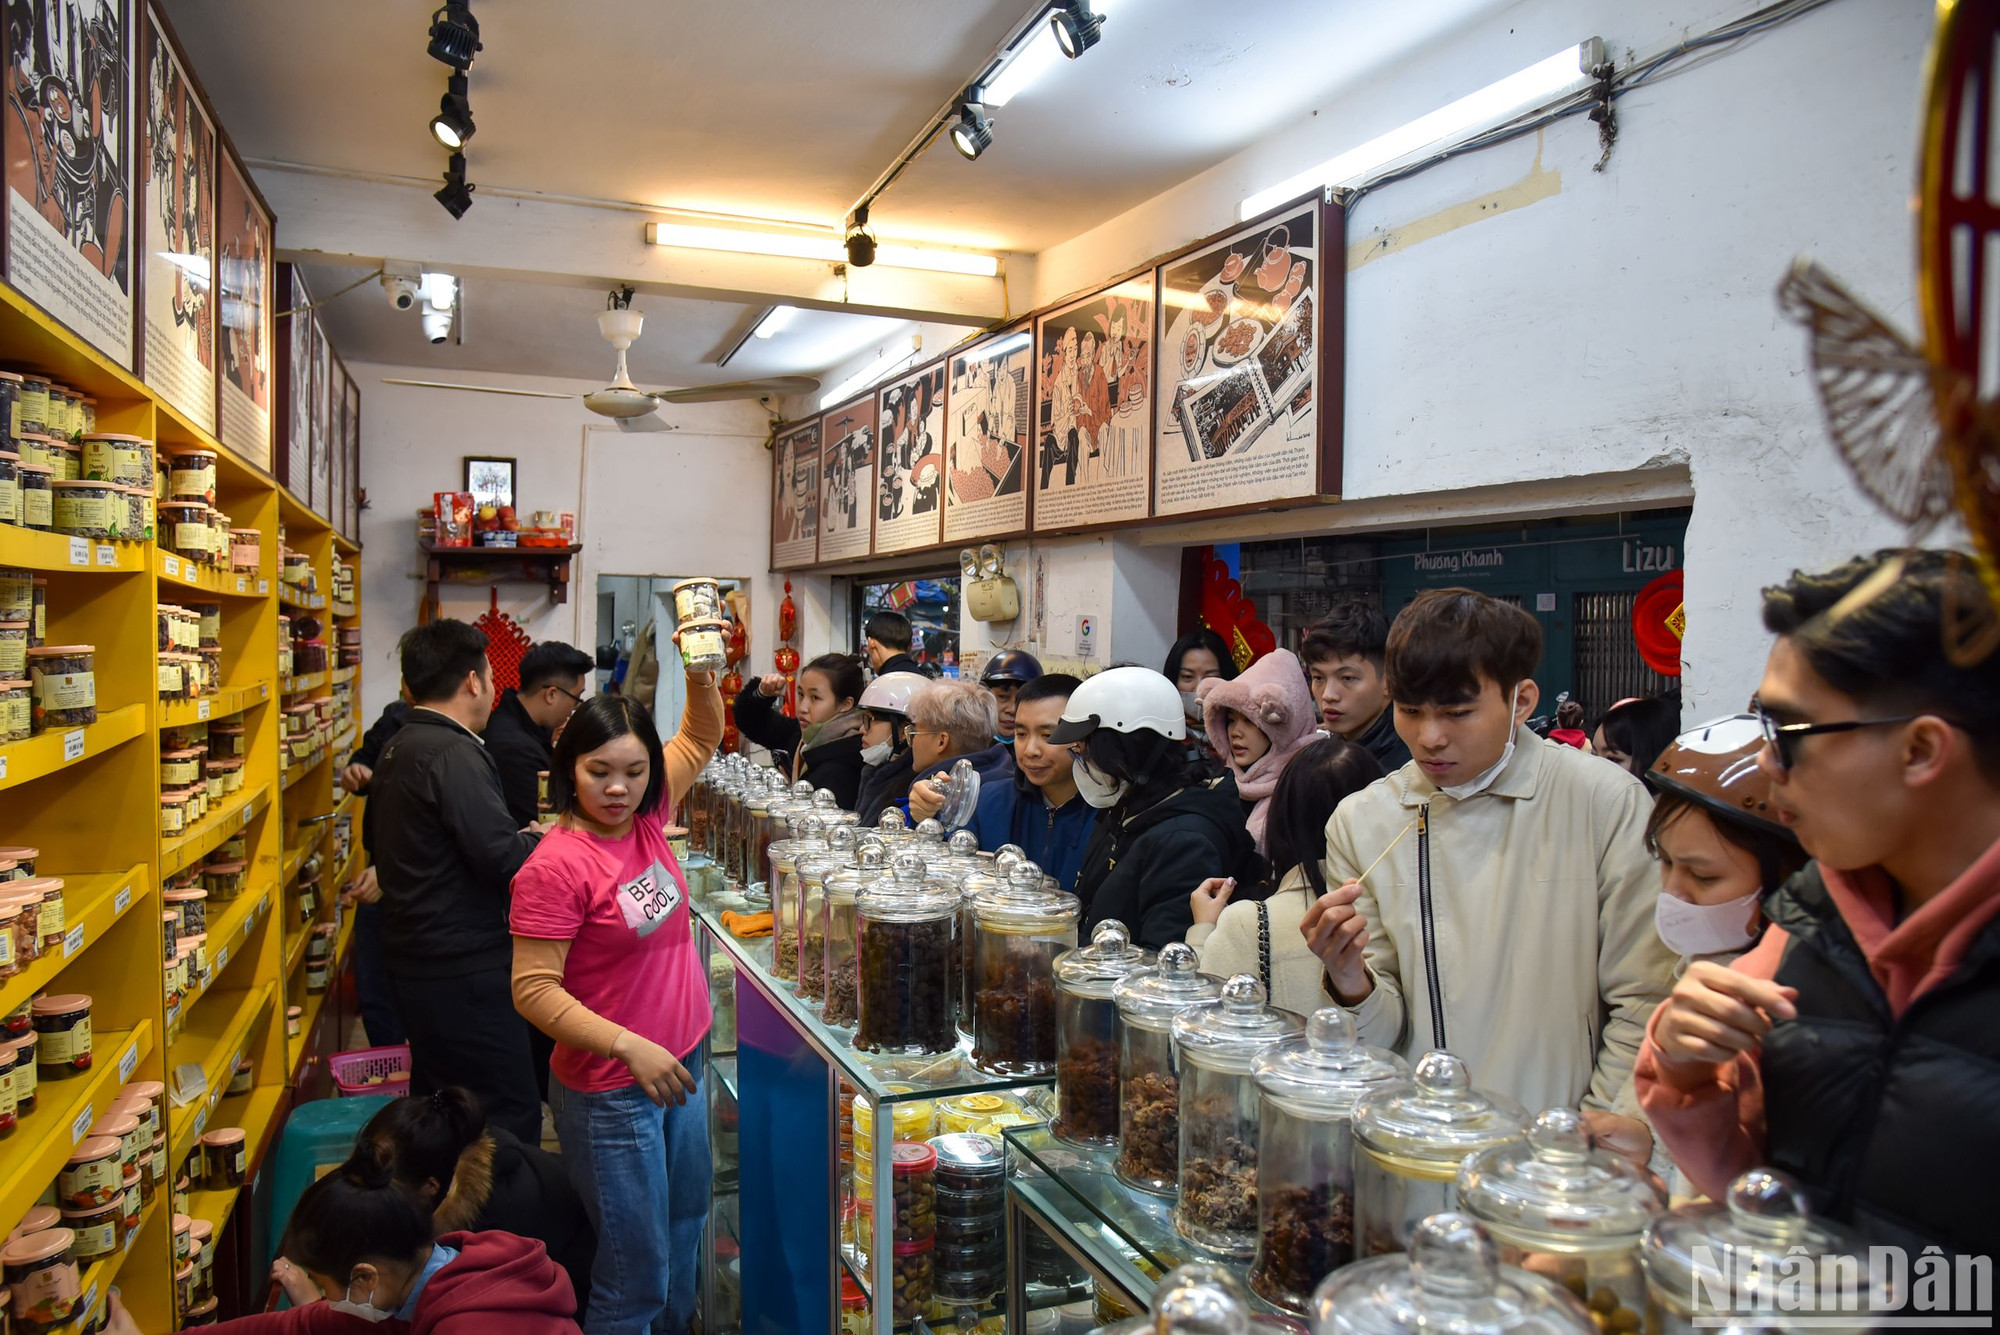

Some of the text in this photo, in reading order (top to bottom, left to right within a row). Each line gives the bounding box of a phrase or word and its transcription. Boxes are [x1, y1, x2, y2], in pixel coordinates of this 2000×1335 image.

[1414, 548, 1503, 572] Phương Khanh
[1623, 540, 1674, 572] Lizu
[628, 877, 654, 903] BE
[643, 888, 674, 920] COOL
